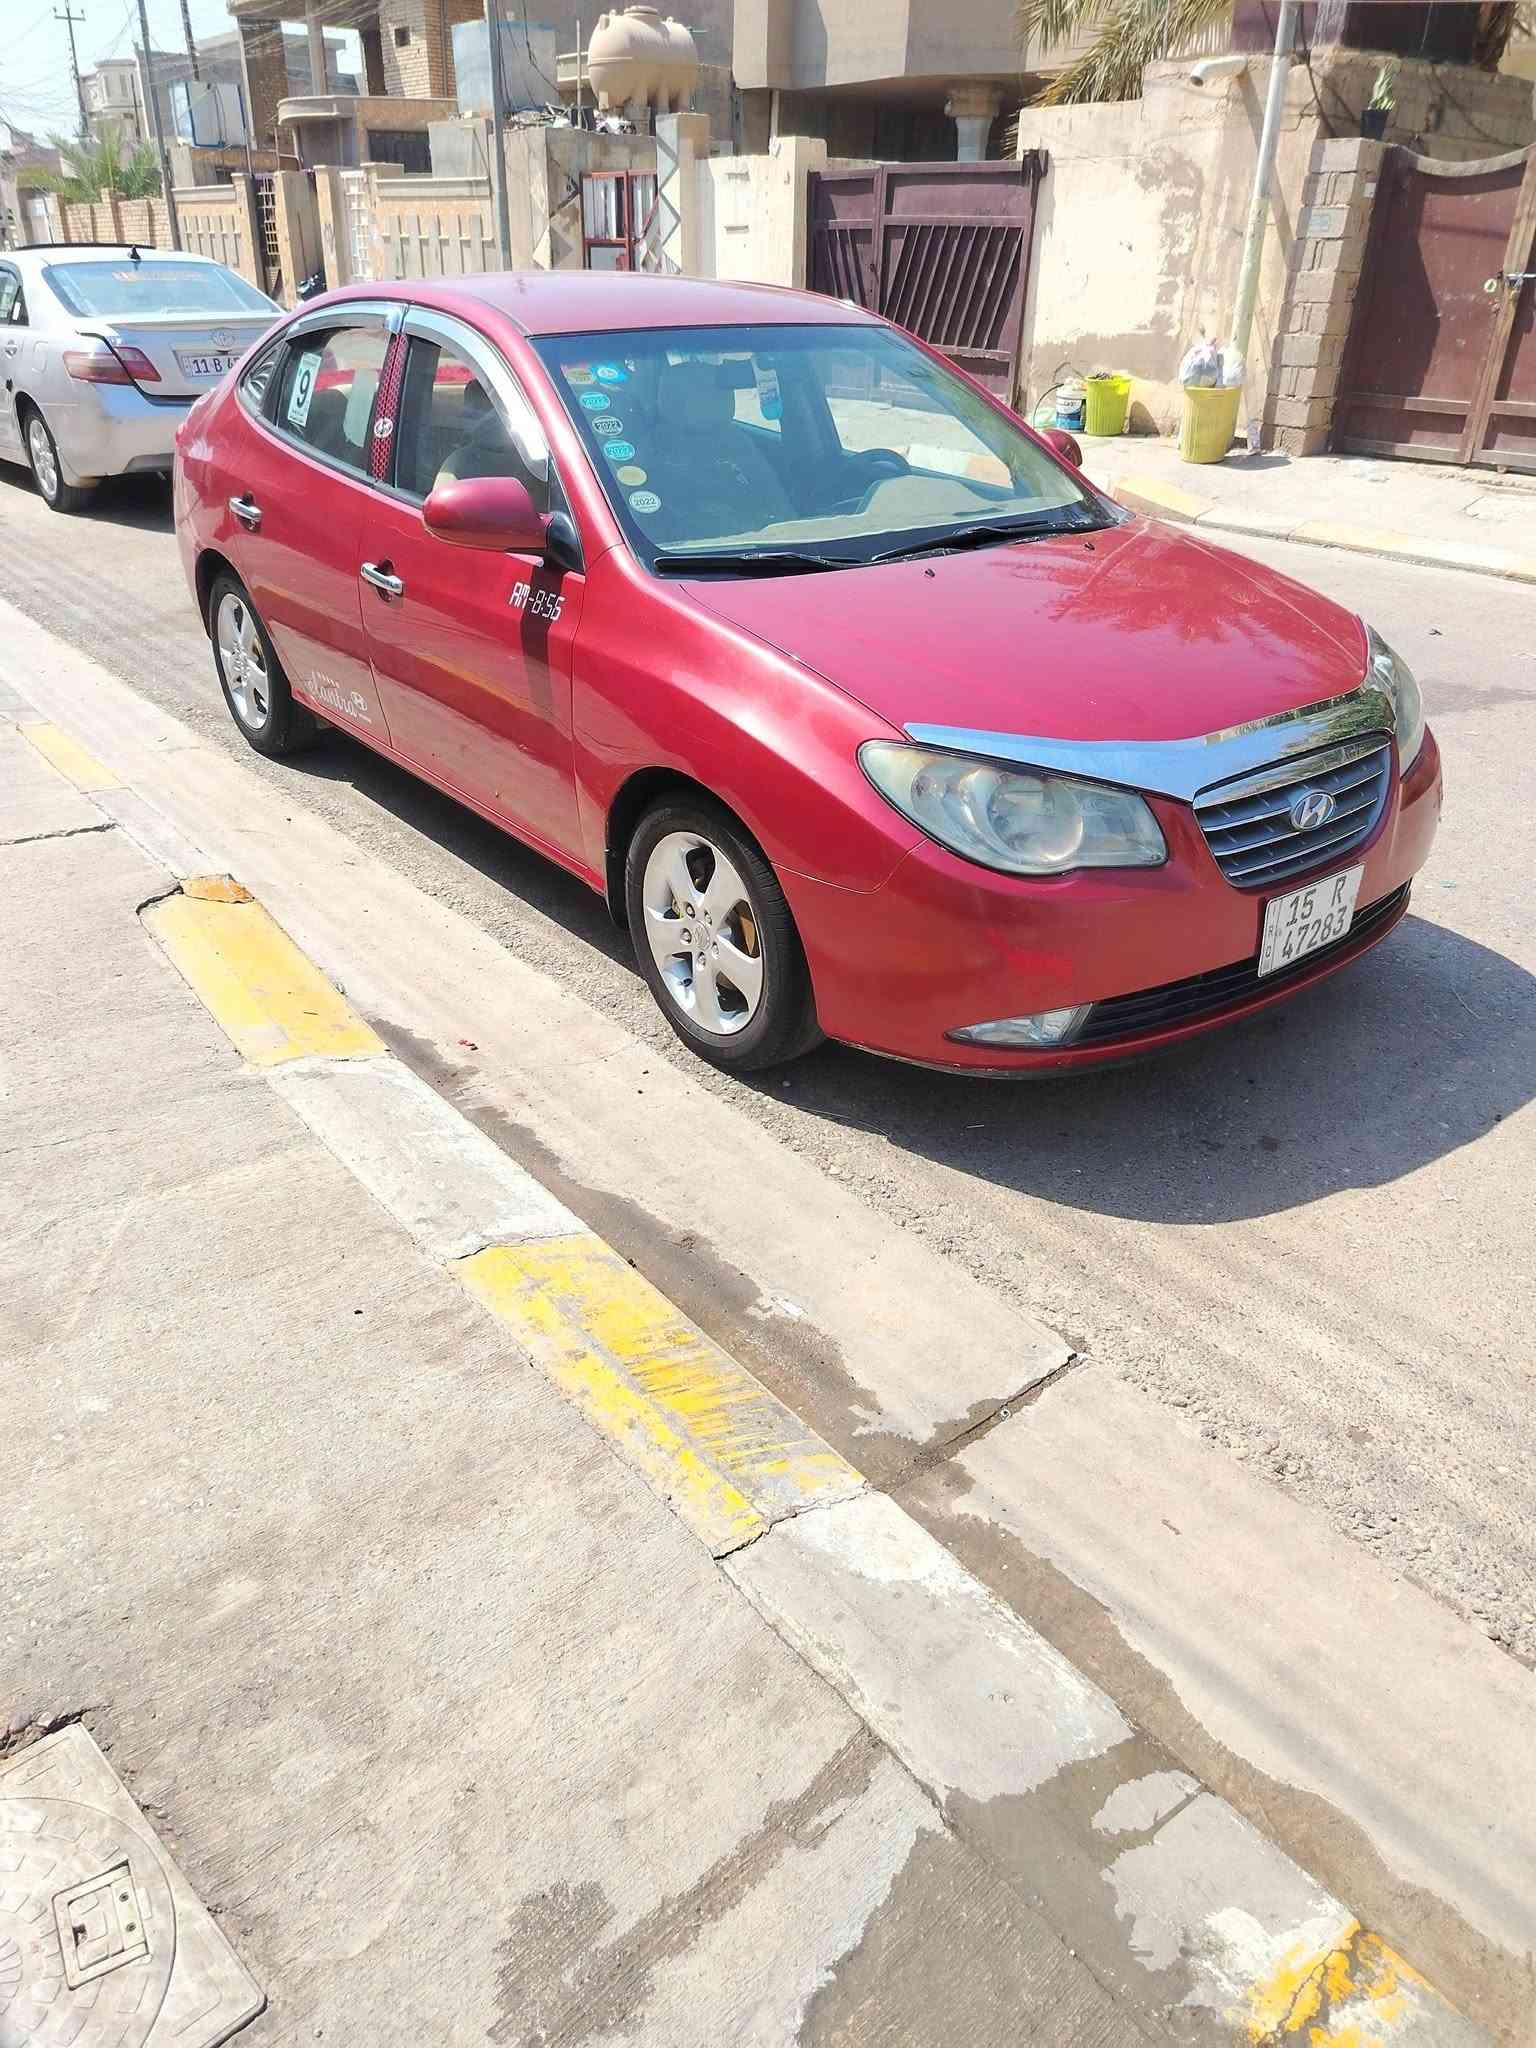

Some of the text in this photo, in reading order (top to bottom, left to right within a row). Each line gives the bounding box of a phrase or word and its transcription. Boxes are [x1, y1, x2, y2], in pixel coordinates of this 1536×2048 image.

[193, 359, 210, 373] 11
[213, 358, 222, 372] B
[634, 496, 656, 506] 2022
[1286, 875, 1347, 926] 15 R
[1282, 905, 1347, 959] 47283
